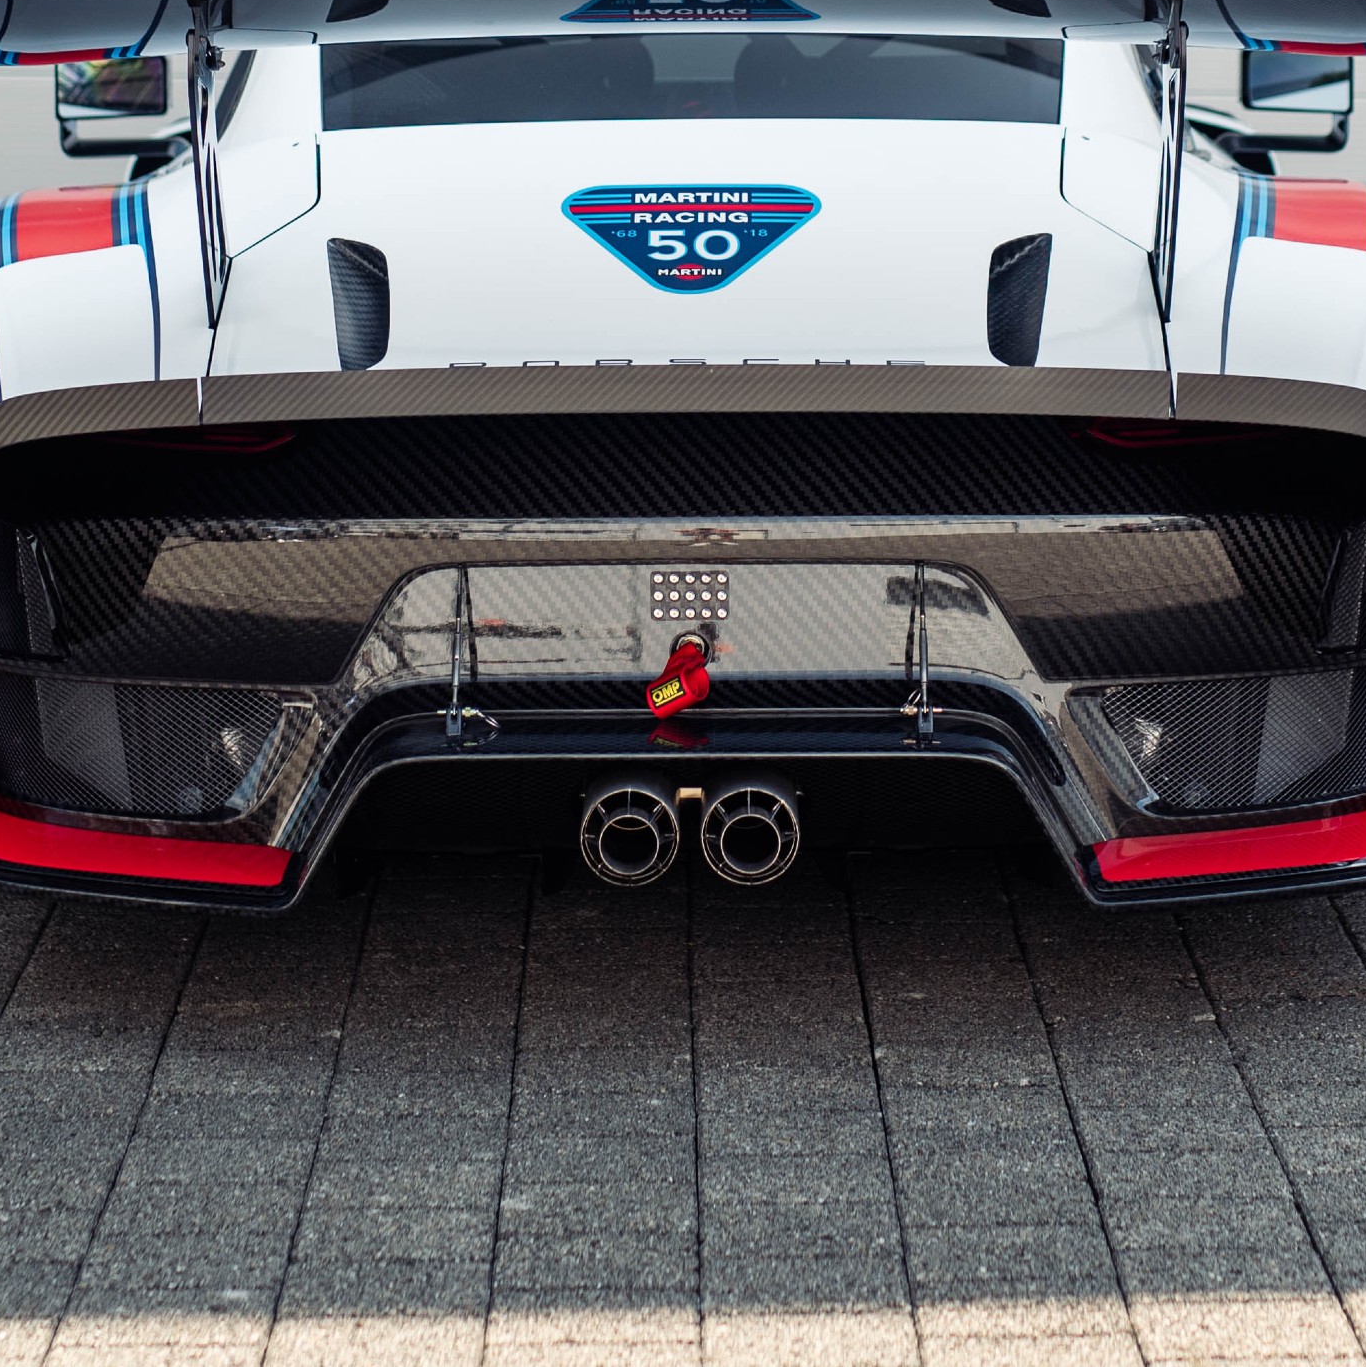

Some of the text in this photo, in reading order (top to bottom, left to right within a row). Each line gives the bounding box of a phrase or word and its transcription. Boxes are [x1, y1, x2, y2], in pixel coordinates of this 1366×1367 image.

[634, 192, 749, 204] MARTINI
[633, 211, 749, 224] RACING
[611, 228, 769, 261] '68 50 '18
[657, 268, 723, 276] MARTINI
[652, 681, 680, 703] OMP
